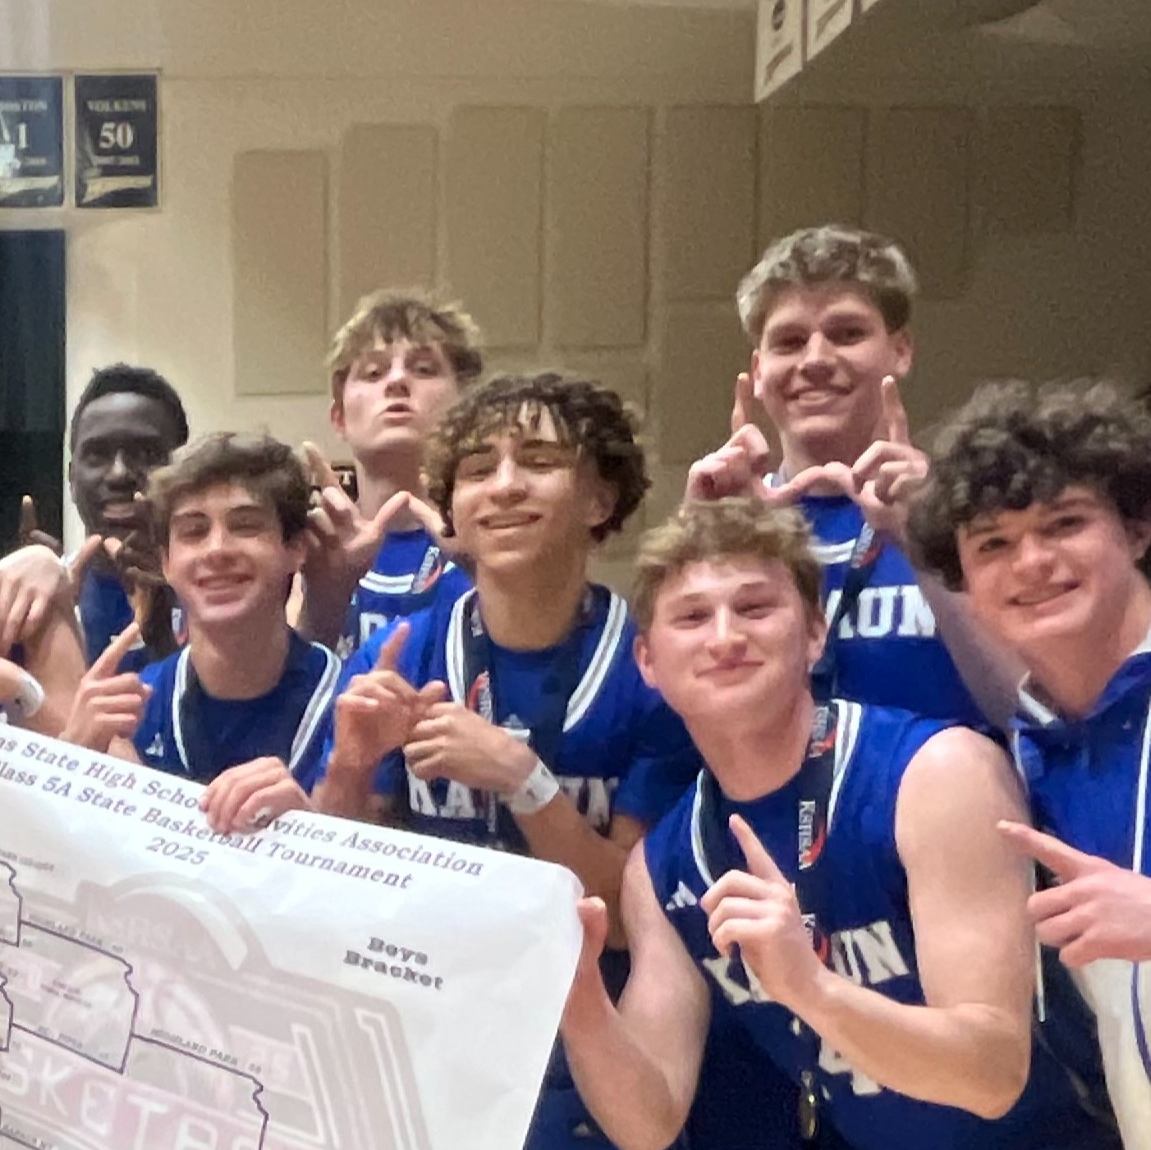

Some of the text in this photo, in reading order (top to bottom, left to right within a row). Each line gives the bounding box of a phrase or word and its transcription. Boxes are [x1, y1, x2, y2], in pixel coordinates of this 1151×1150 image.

[99, 122, 134, 149] 50
[21, 741, 79, 771] State
[84, 762, 139, 791] High
[143, 780, 200, 812] Scho
[341, 831, 486, 877] Association
[42, 776, 73, 799] 5A
[76, 786, 137, 817] State
[140, 806, 264, 855] Basketball
[269, 842, 413, 889] Tournament
[146, 837, 210, 866] 2025
[366, 936, 428, 966] Boys
[342, 949, 444, 991] Bracket
